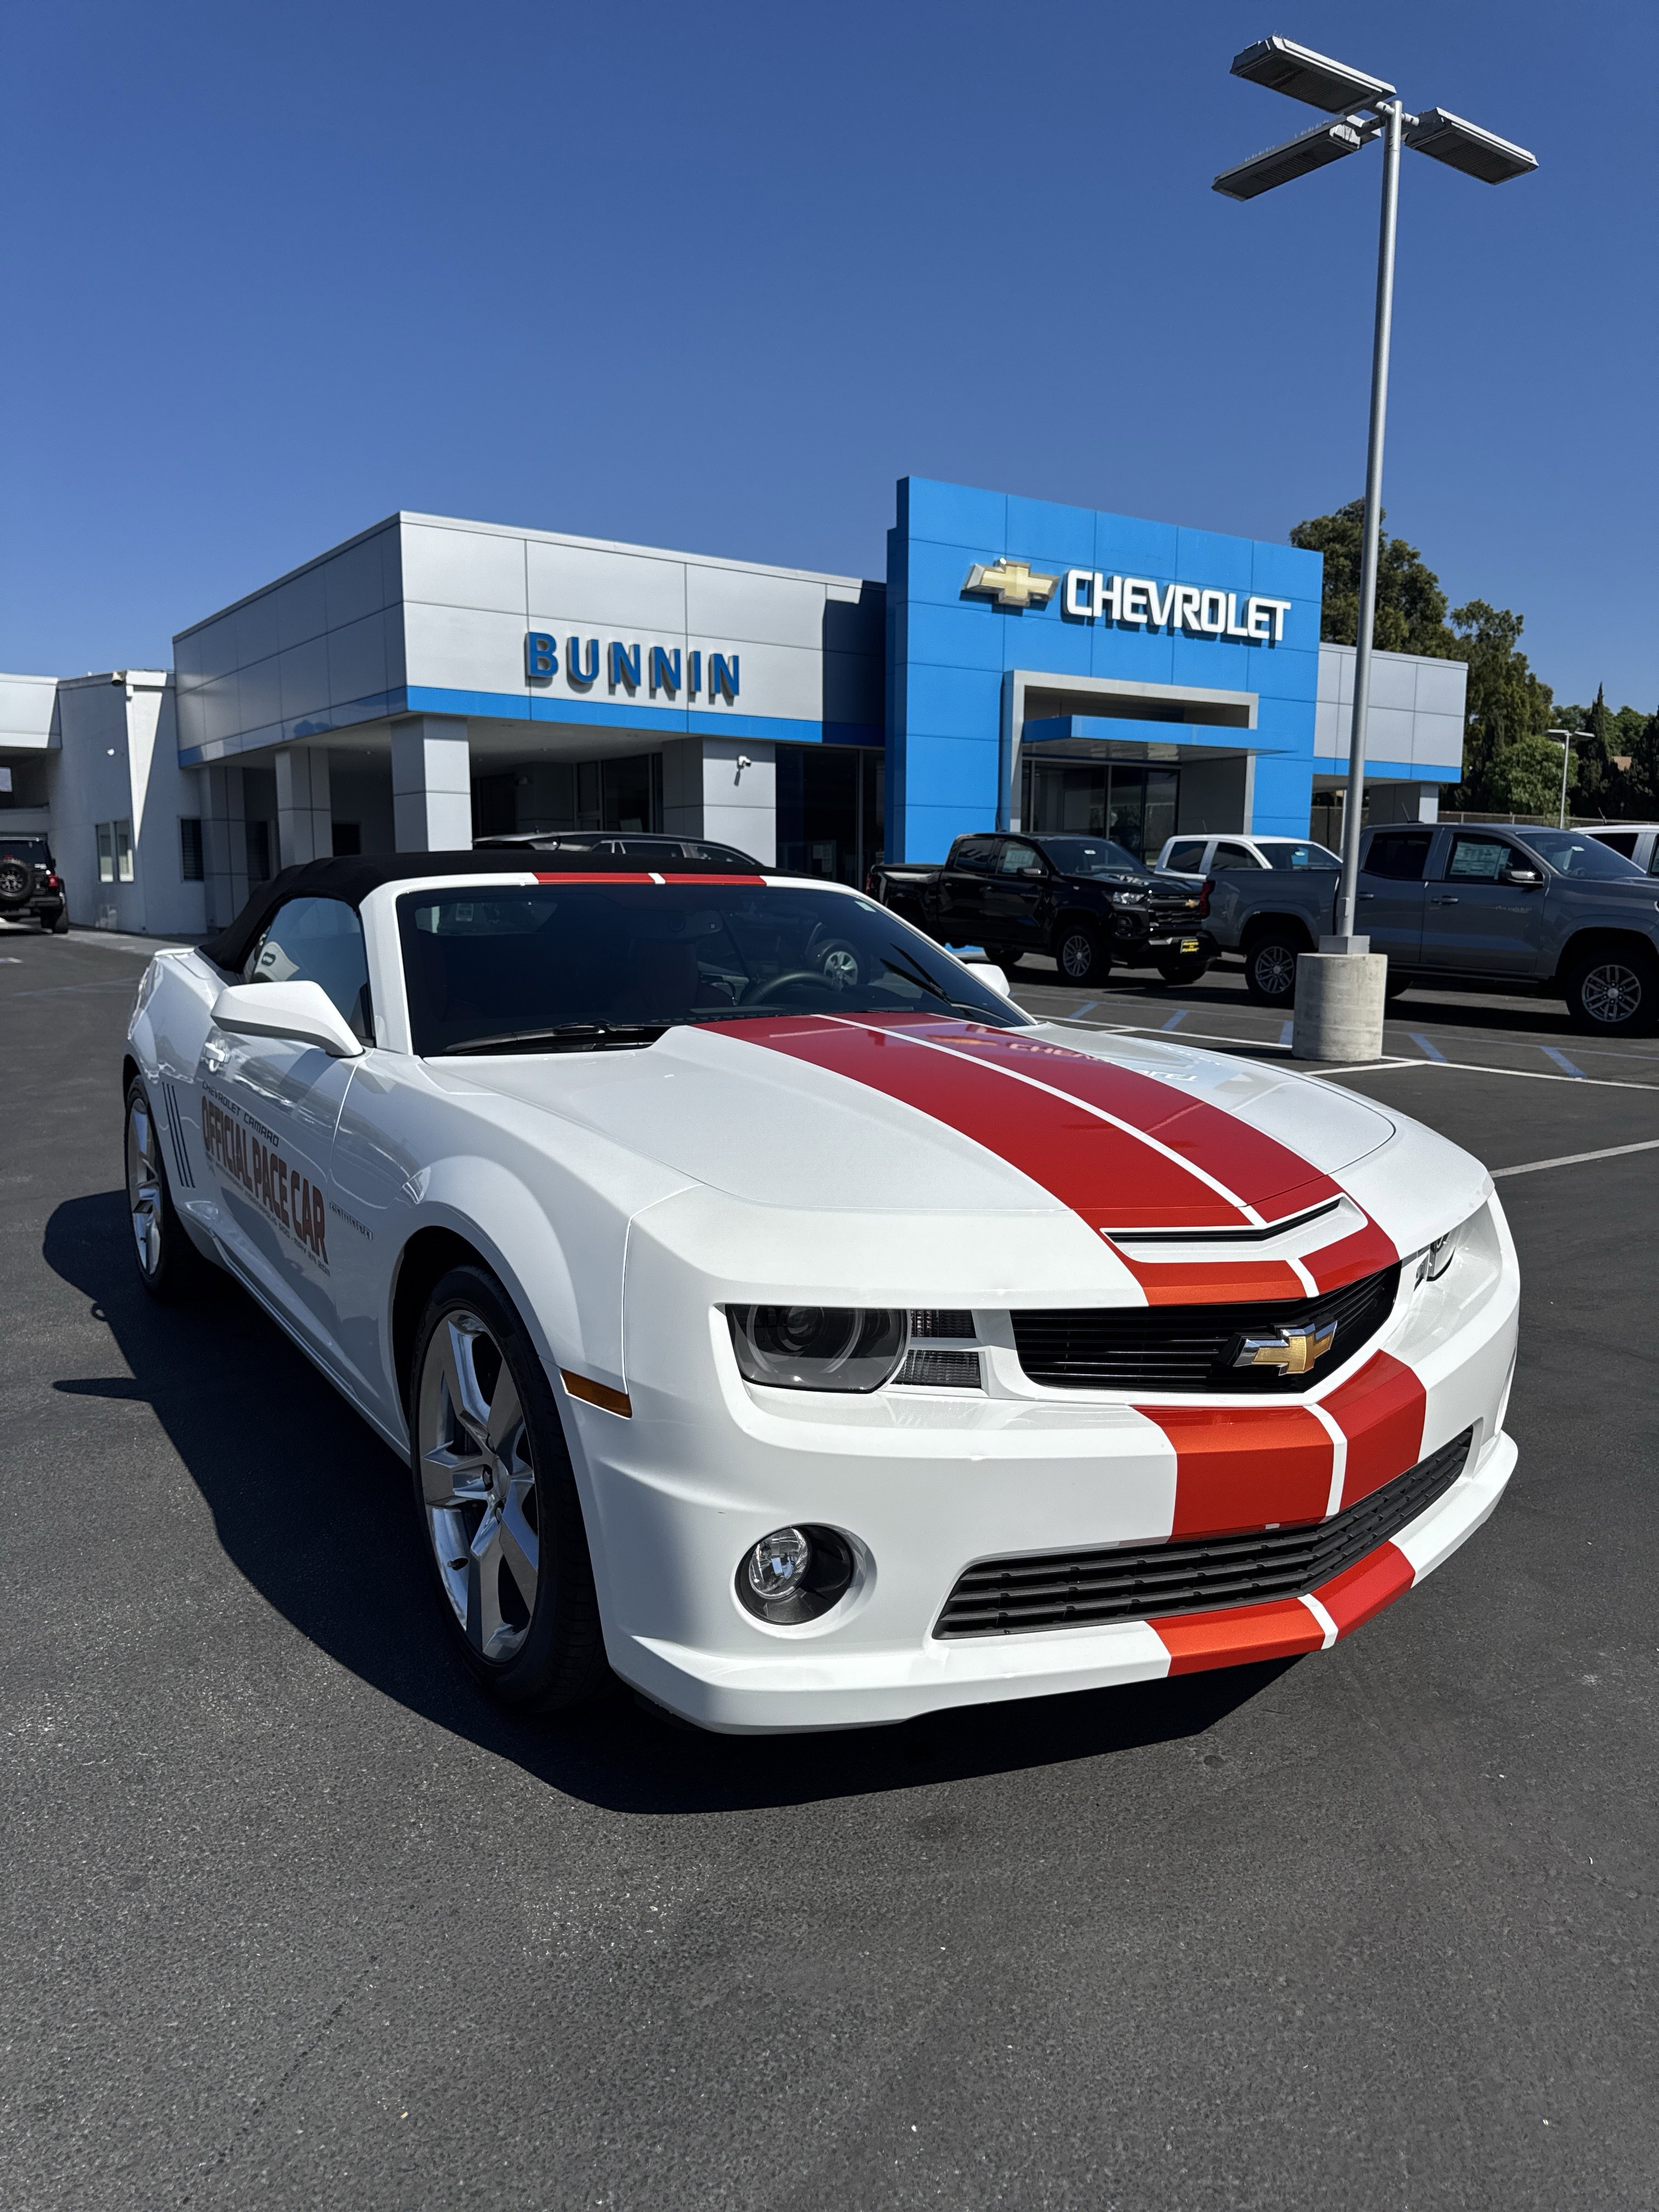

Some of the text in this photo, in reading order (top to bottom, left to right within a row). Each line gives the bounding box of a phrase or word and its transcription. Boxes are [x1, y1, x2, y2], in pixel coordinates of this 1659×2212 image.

[1065, 569, 1291, 641] CHEVROLET
[525, 631, 740, 697] BUNNIN
[202, 1079, 279, 1147] CHEVROLET CAMARO
[201, 1096, 253, 1193] OFFICIAL
[253, 1137, 290, 1228] PACE
[291, 1170, 329, 1265] CAR
[318, 1260, 330, 1277] 2011
